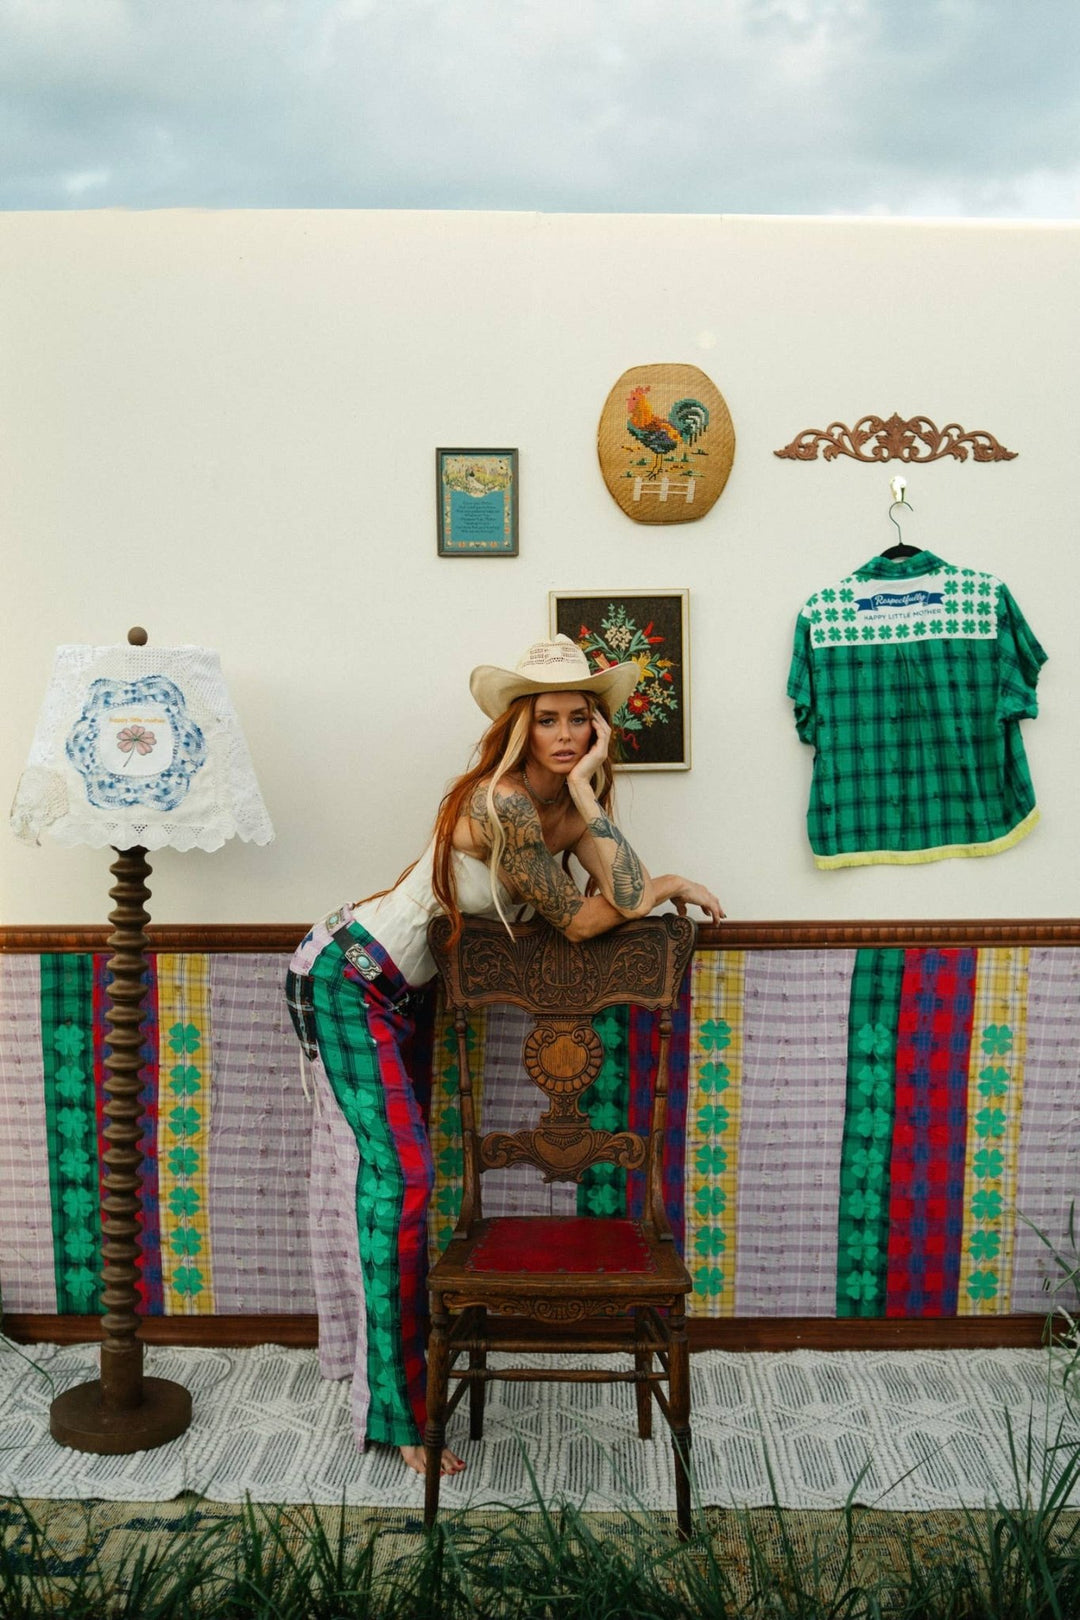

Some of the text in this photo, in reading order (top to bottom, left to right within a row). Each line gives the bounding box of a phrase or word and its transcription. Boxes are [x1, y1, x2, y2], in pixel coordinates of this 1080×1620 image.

[874, 593, 926, 606] Respectfully
[888, 612, 911, 620] LITTLE
[913, 608, 942, 616] MOTHER
